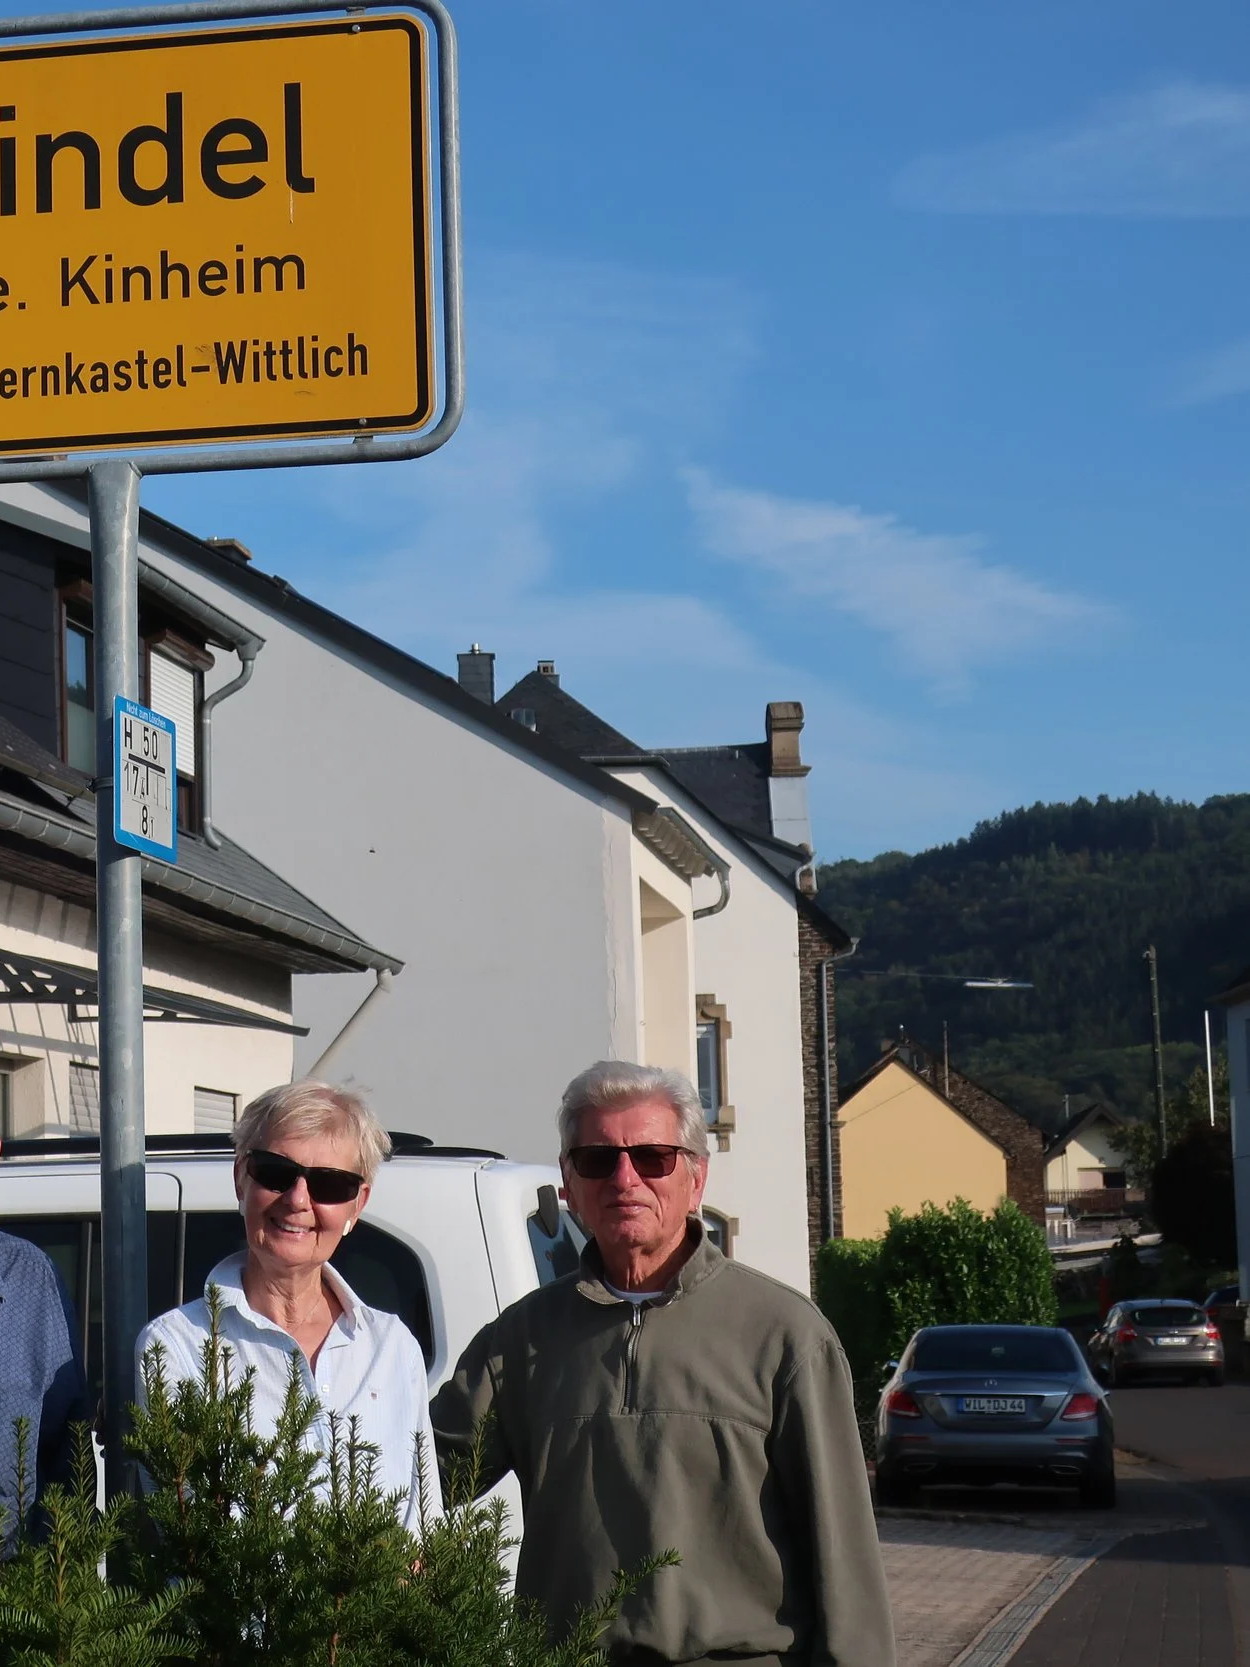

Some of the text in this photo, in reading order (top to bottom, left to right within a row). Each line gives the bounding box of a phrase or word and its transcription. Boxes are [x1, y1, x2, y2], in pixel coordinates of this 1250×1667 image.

[60, 244, 305, 306] Kinheim
[124, 717, 158, 760] H 50
